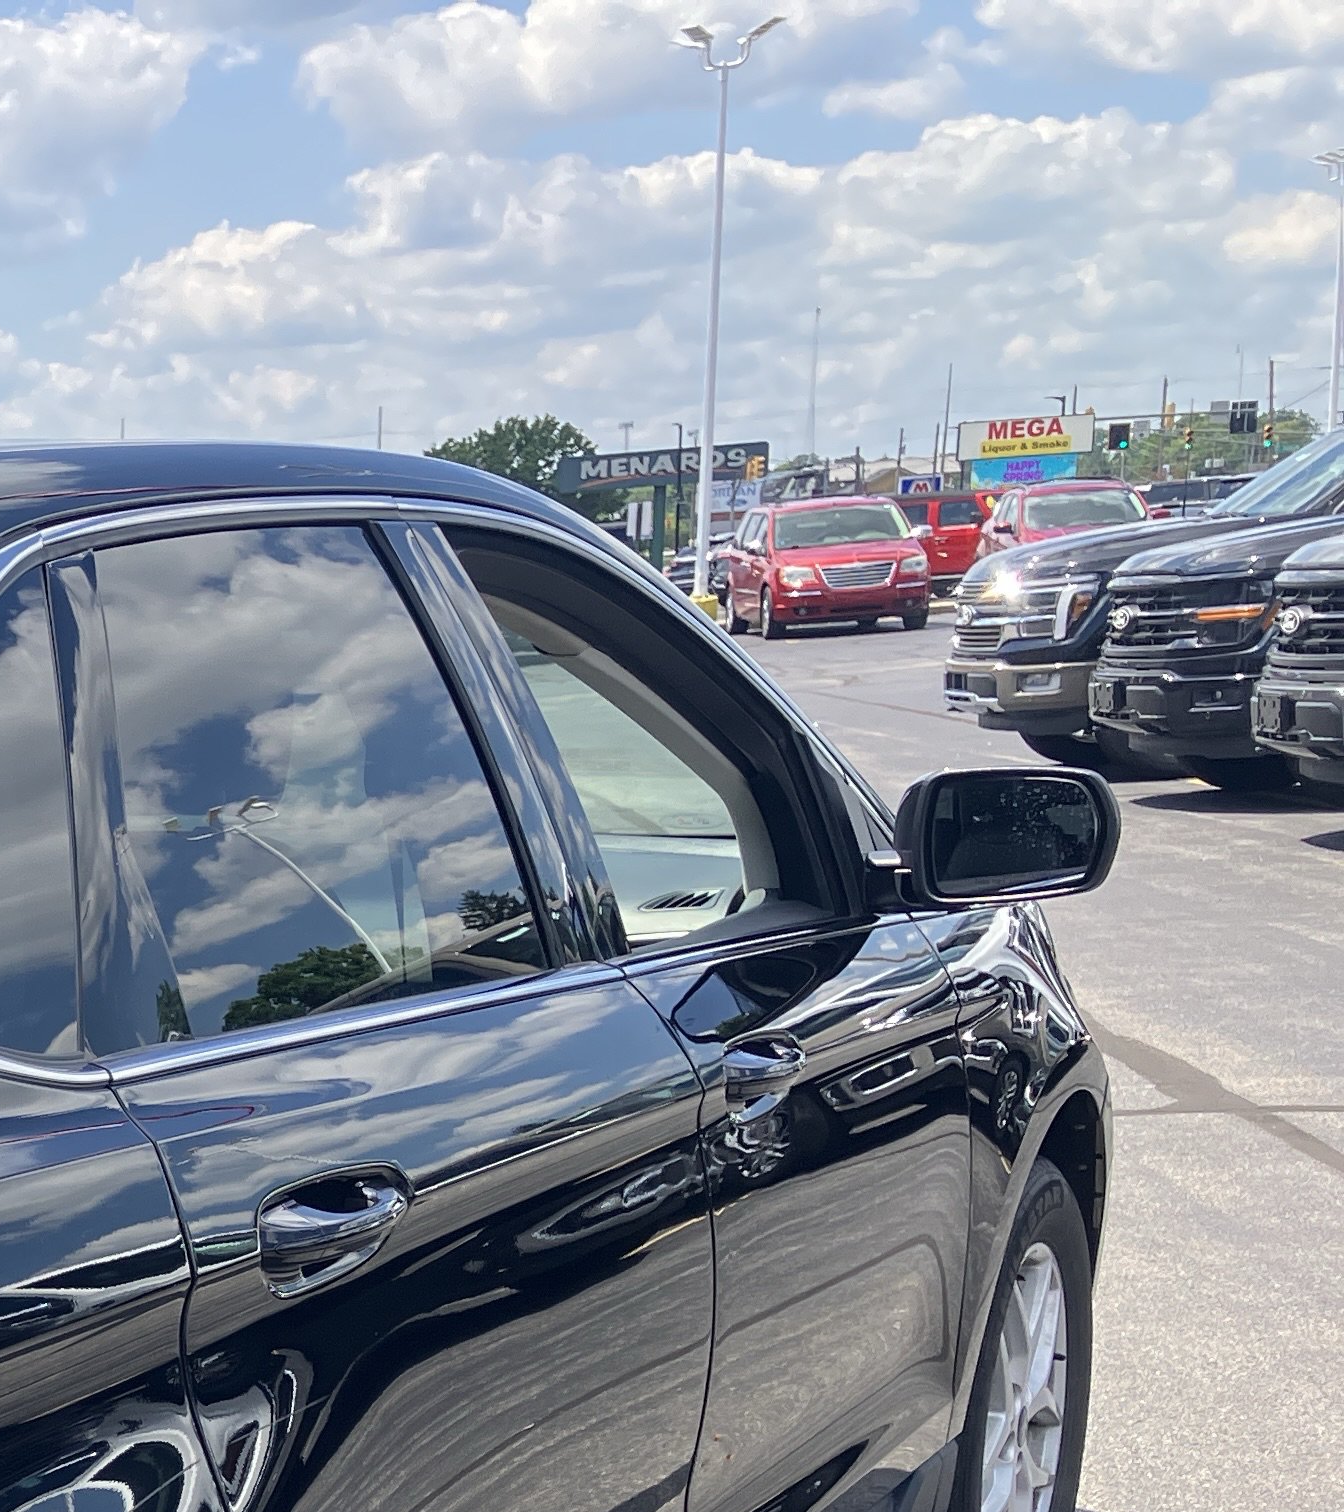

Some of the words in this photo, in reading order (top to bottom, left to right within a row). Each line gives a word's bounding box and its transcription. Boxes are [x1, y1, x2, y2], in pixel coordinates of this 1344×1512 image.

[987, 417, 1064, 440] MEGA
[982, 444, 1018, 454] Liquor
[1020, 442, 1028, 451] &
[1031, 440, 1069, 449] Smoke
[579, 447, 747, 481] MENARDS
[1006, 460, 1041, 471] HAPPY
